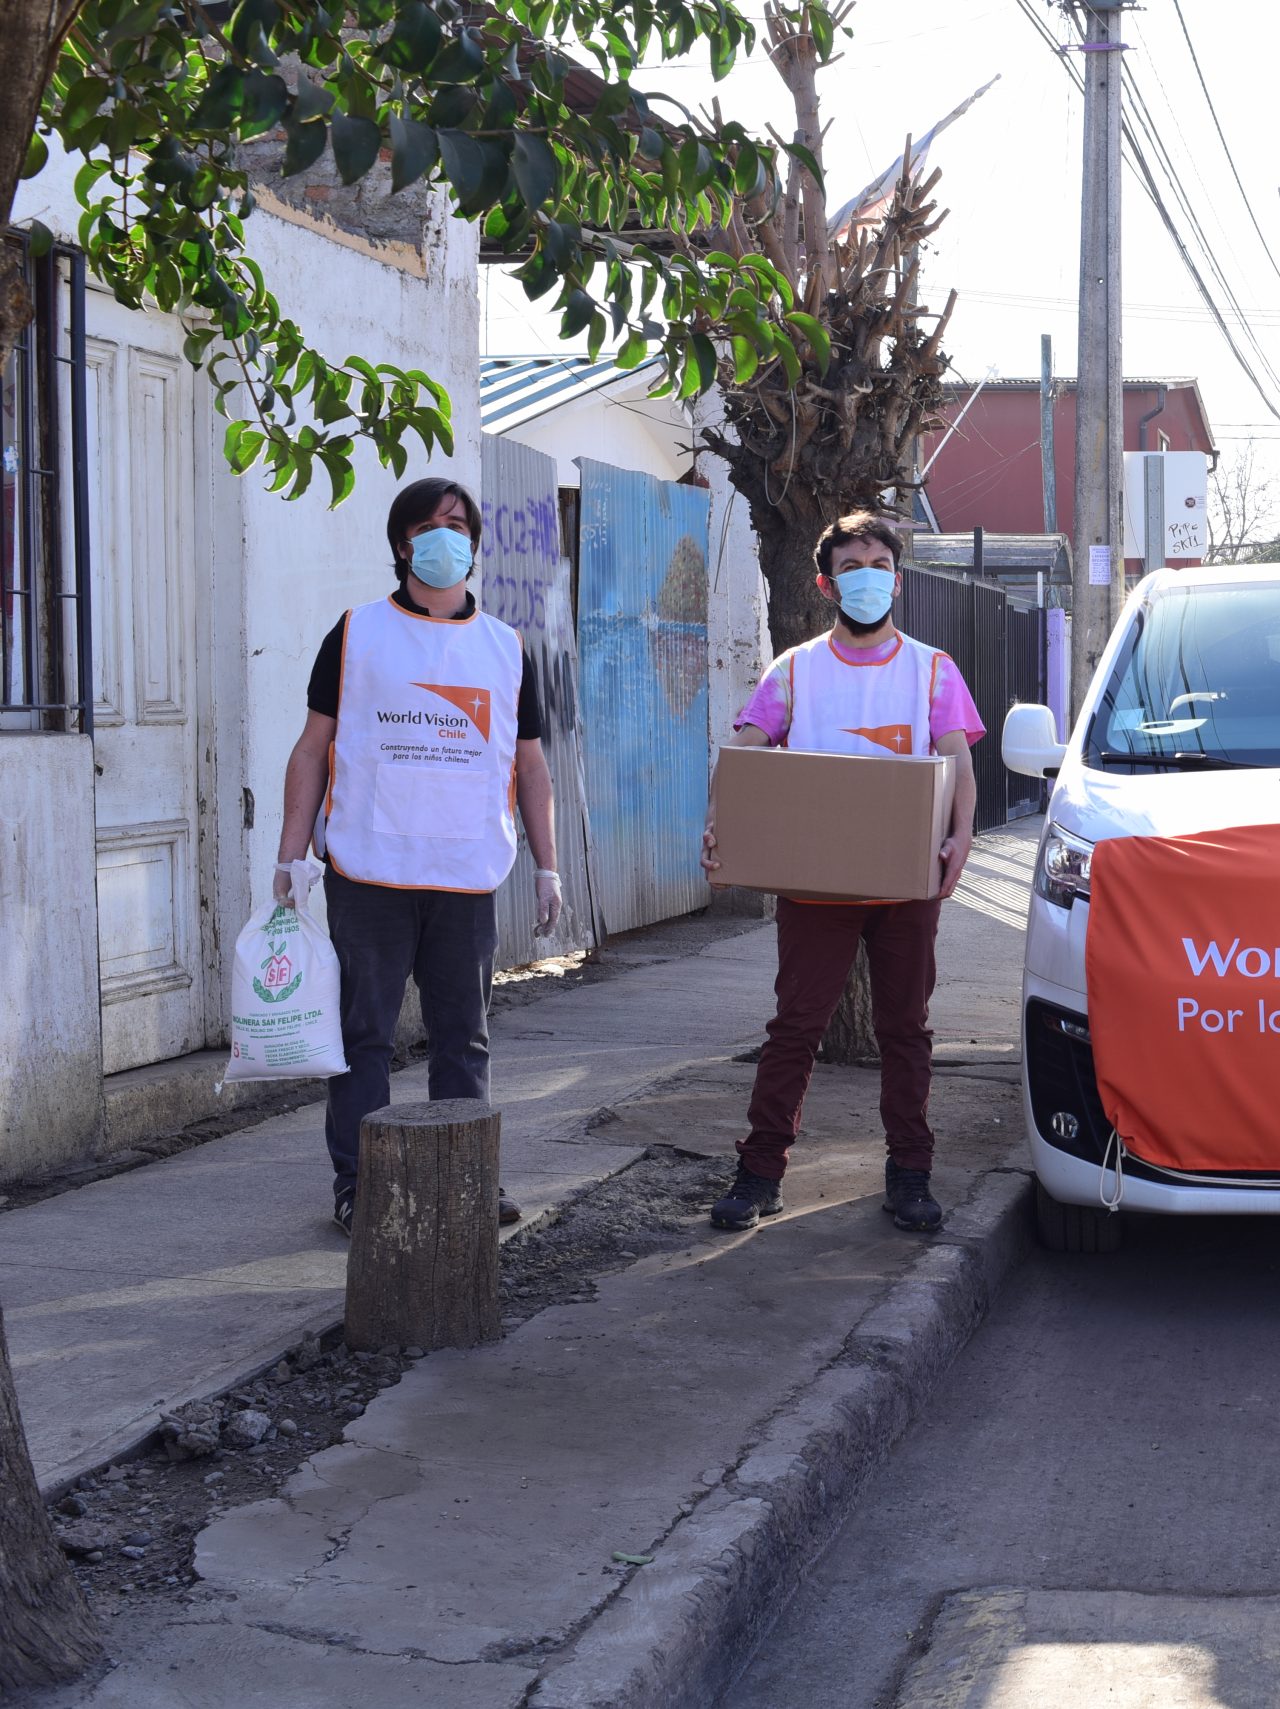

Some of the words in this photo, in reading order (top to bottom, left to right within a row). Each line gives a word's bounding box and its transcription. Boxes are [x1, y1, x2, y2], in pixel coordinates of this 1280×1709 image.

[377, 710, 422, 725] World
[424, 713, 468, 728] Vision
[438, 729, 467, 739] Chile
[380, 743, 429, 753] Construyendo
[441, 746, 462, 755] futuro
[463, 748, 483, 757] mejor
[392, 753, 409, 761] para
[411, 752, 422, 761] los
[424, 754, 442, 762] niños
[444, 755, 470, 764] chilenos
[261, 1018, 276, 1027] SAN
[277, 1014, 303, 1025] FELIPE
[1177, 997, 1244, 1032] Por
[233, 1041, 240, 1058] 5
